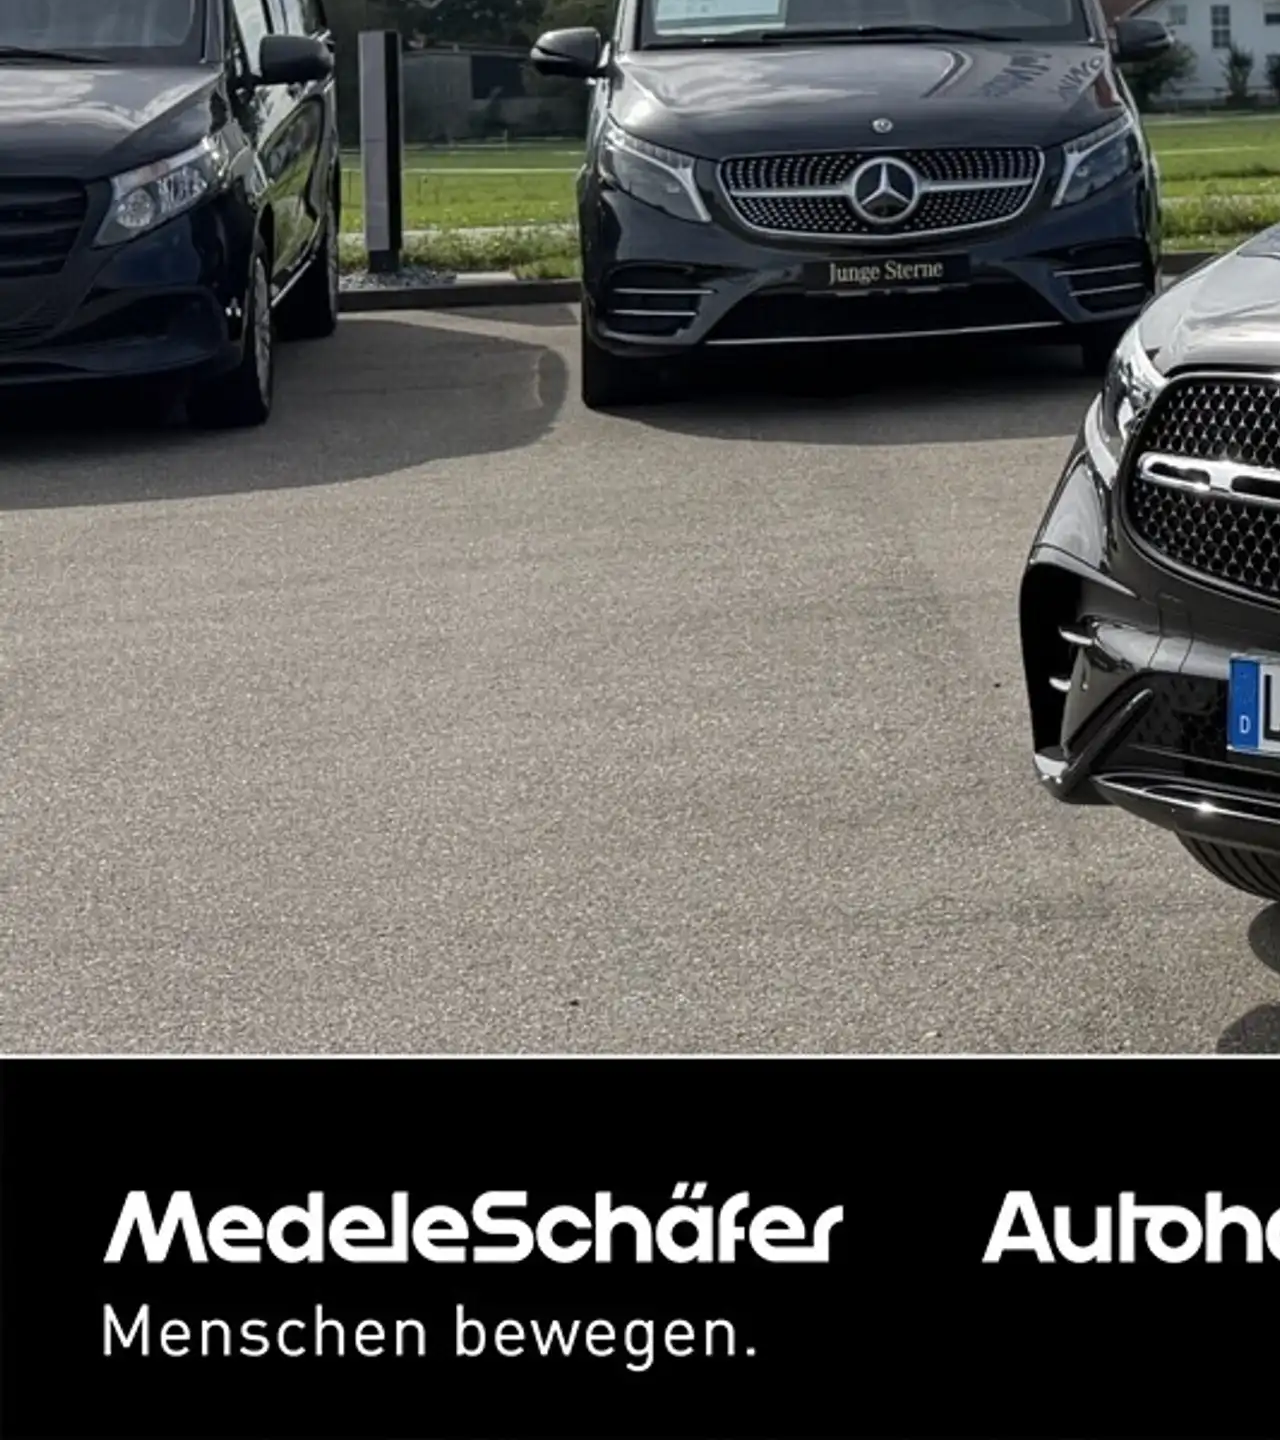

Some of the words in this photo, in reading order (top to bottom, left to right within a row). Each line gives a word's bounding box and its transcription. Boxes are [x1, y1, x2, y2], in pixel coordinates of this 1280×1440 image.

[828, 262, 881, 285] Junge
[884, 260, 944, 280] Sterne
[1238, 714, 1251, 735] D
